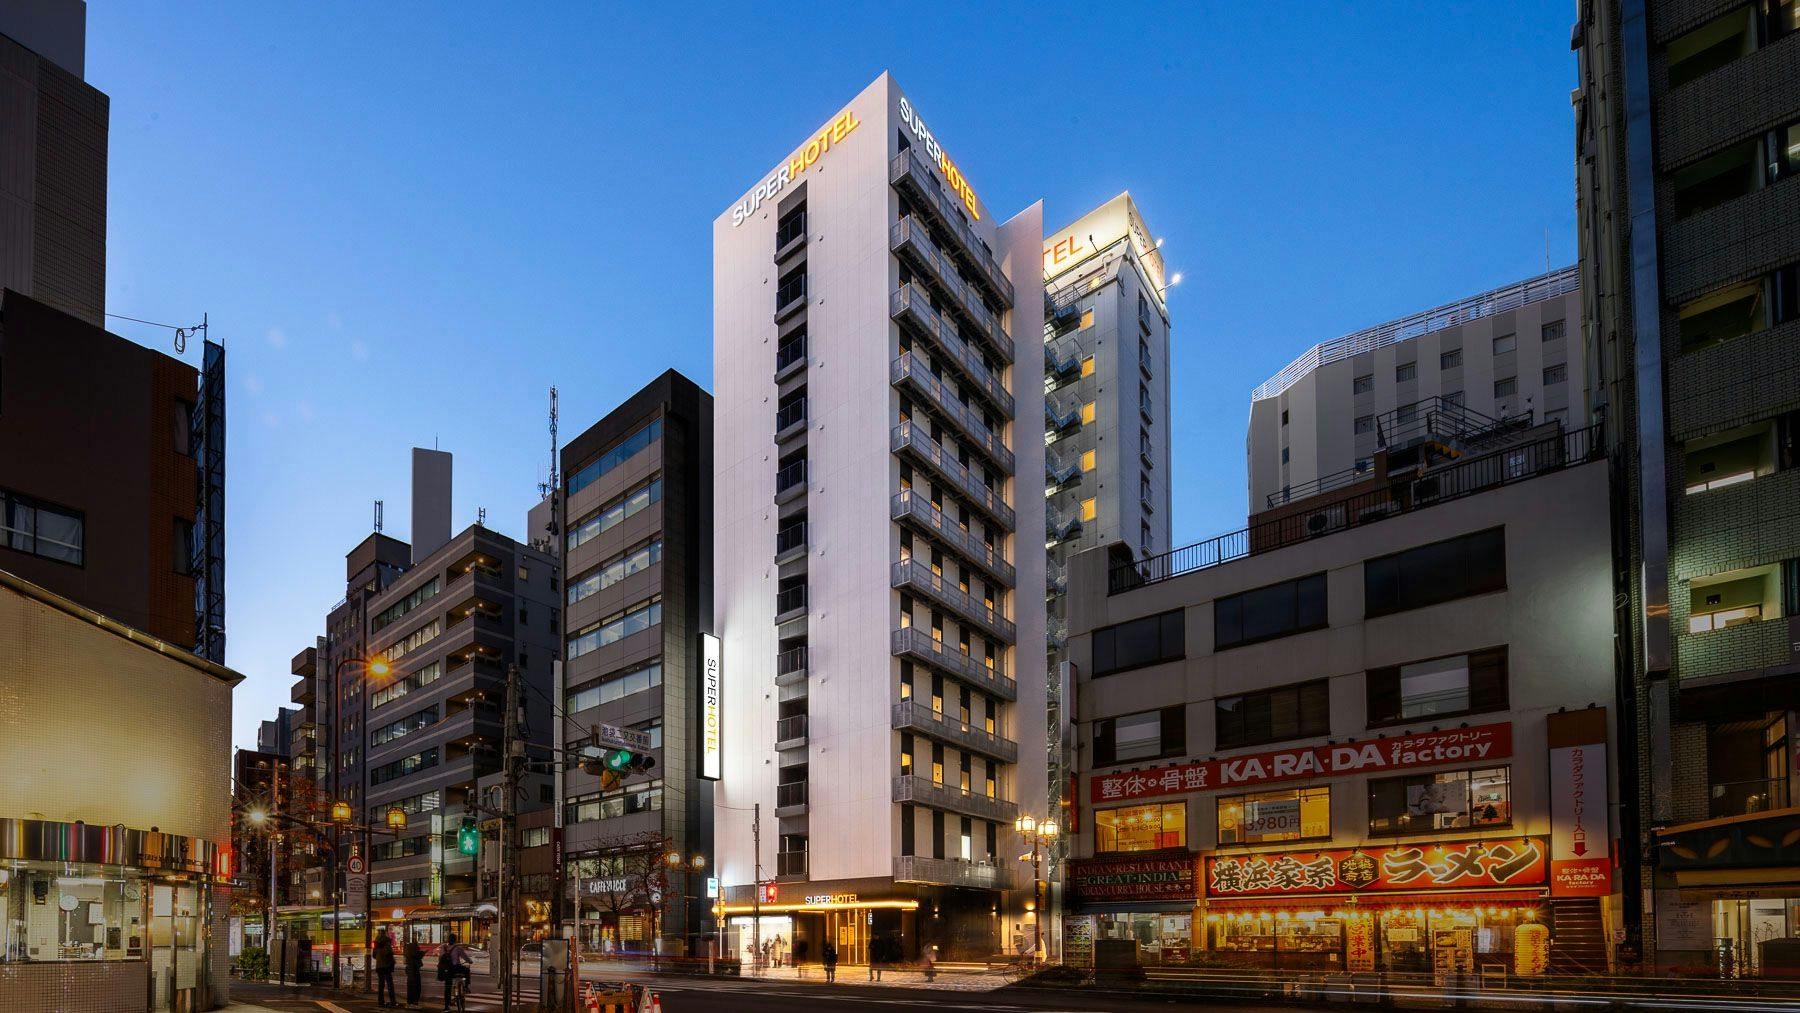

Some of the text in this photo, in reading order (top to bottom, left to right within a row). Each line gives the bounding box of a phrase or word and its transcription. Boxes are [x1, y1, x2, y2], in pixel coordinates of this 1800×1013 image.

[732, 110, 860, 227] SUPERHOTEL
[900, 97, 980, 220] SUPERHOTEL
[707, 658, 716, 754] SUPERHOTEL
[1392, 731, 1492, 750] カラダファクトリー
[1392, 742, 1492, 764] factory
[1571, 748, 1585, 841] カラダファクトリー入口
[1212, 855, 1337, 891] 横浜家系
[1382, 843, 1540, 884] ラーメン
[805, 894, 860, 905] SUPERHOTEL
